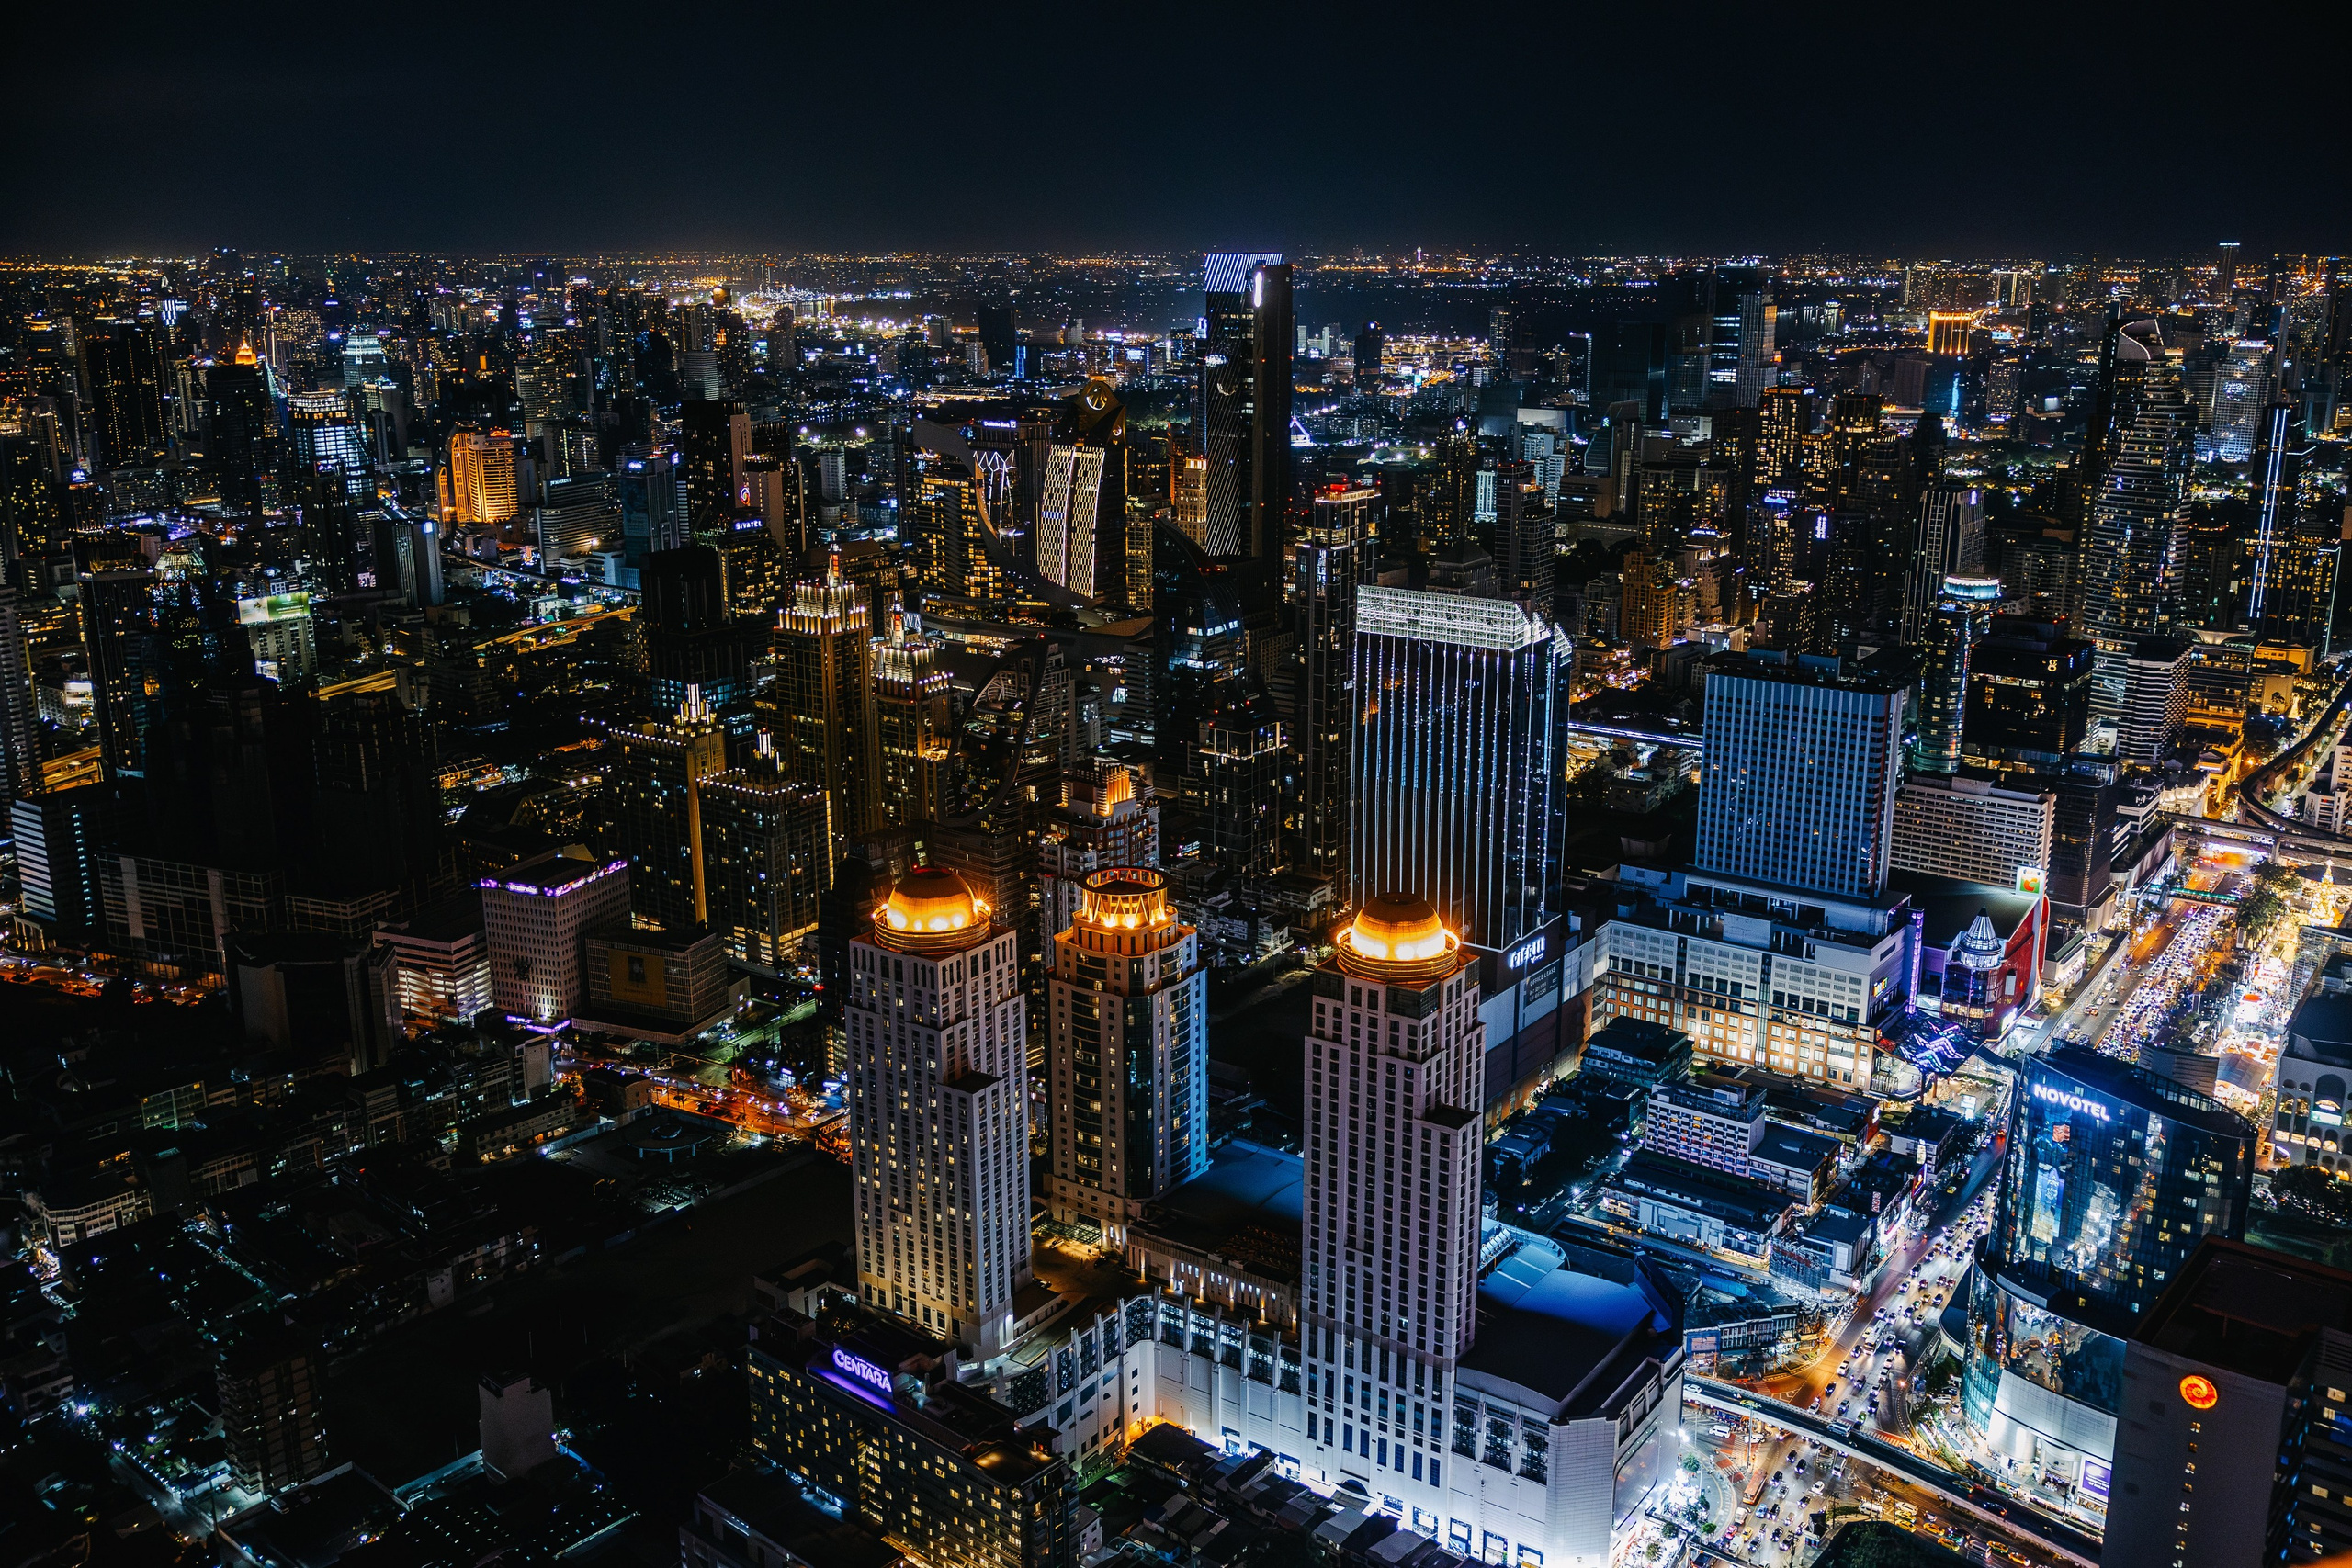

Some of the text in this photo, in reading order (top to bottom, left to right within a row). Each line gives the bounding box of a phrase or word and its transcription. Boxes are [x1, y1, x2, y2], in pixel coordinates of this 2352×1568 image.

[735, 519, 763, 531] SIVATEL
[1530, 974, 1544, 987] OFFICE
[1544, 966, 1556, 978] LEASE
[2033, 1083, 2110, 1122] NOVOTEL
[832, 1349, 892, 1393] CENTARA
